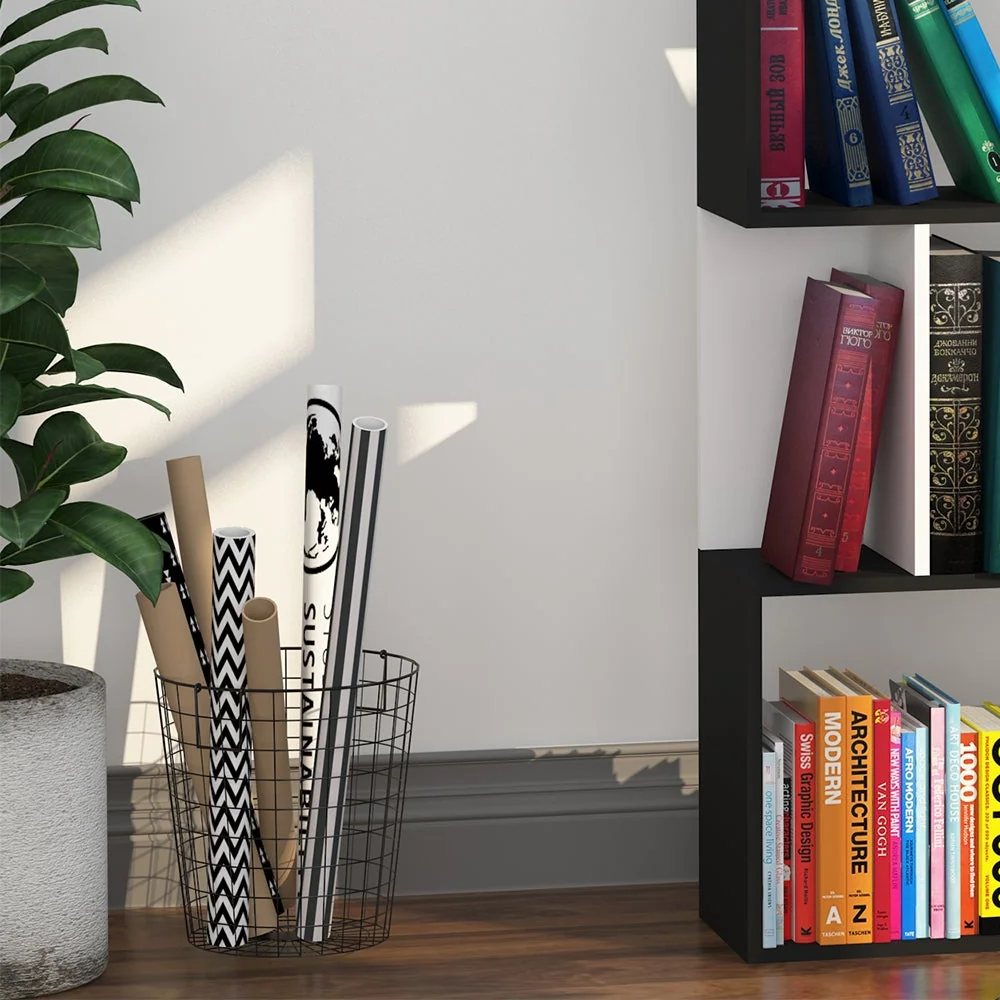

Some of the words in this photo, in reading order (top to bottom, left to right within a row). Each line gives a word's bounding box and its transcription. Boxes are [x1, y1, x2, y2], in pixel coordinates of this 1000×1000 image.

[768, 54, 786, 83] ЗОВ
[835, 44, 854, 93] Джек
[767, 87, 786, 152] ВЕЧНЫЙ
[899, 105, 910, 120] 4
[849, 132, 857, 144] 6
[774, 183, 782, 197] 1
[840, 334, 872, 349] ГЮГО
[842, 326, 873, 338] ВИКТОР
[933, 348, 977, 356] БОККАЧЧО
[841, 531, 849, 543] 5
[815, 545, 823, 557] 4
[950, 726, 959, 746] ART
[800, 733, 813, 769] Swiss
[824, 712, 842, 805] MODERN
[890, 748, 899, 767] NEW
[905, 747, 914, 781] AFRO
[890, 767, 899, 790] WAYS
[950, 750, 959, 782] DECO
[960, 741, 978, 802] 1000
[798, 772, 813, 819] Graphic
[850, 710, 868, 875] ARCHITECTURE
[877, 782, 887, 810] VAN
[890, 790, 899, 812] WITH
[950, 785, 959, 823] HOUSE
[905, 782, 914, 833] MODERN
[763, 809, 773, 836] space
[890, 813, 899, 837] PAINT
[798, 822, 813, 863] Design
[877, 816, 887, 857] GOGH
[763, 838, 774, 864] living
[825, 905, 842, 925] A
[852, 904, 867, 924] Z
